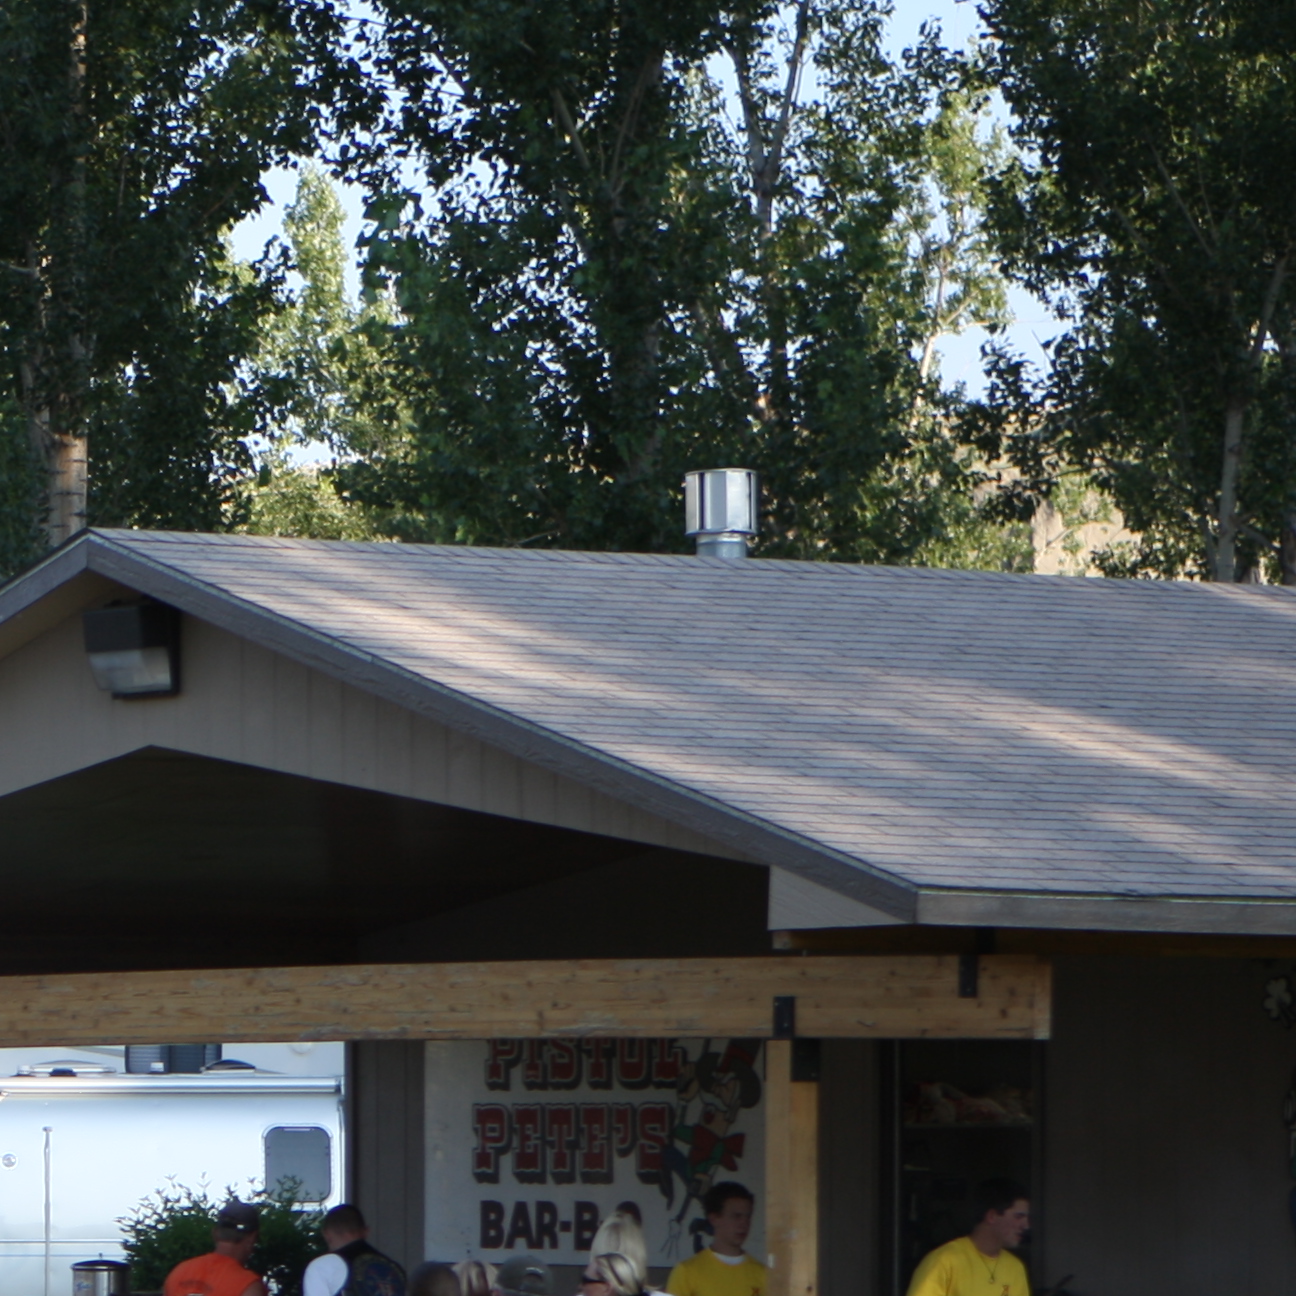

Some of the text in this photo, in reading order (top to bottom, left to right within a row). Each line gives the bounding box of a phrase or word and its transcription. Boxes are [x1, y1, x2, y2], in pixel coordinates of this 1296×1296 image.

[485, 1038, 685, 1090] PISTOL
[472, 1102, 675, 1184] PETE'S
[480, 1200, 643, 1250] BAR-B
